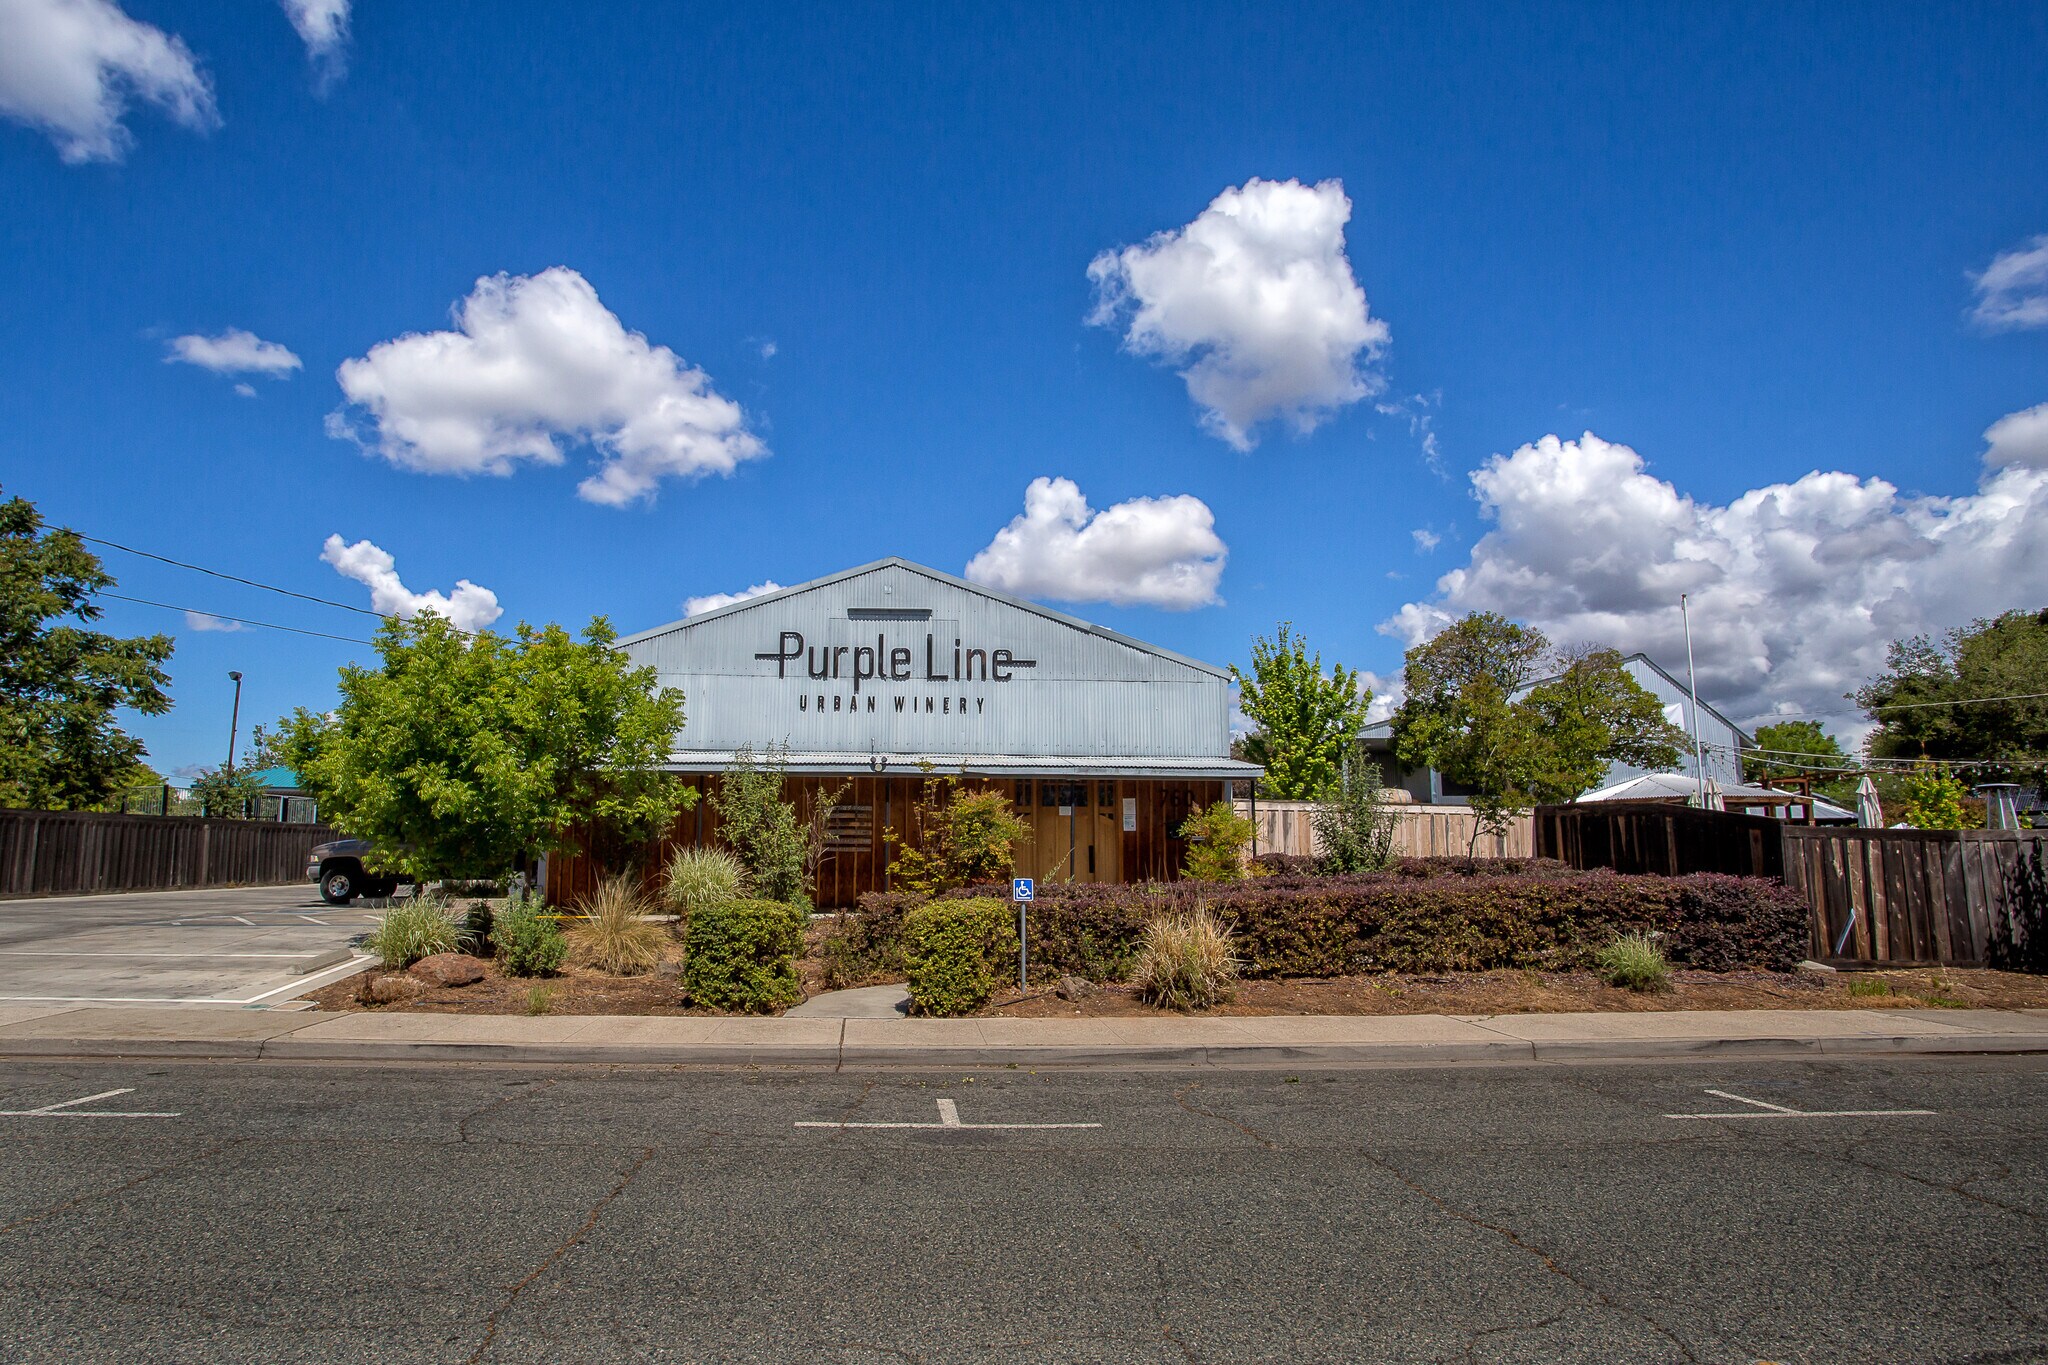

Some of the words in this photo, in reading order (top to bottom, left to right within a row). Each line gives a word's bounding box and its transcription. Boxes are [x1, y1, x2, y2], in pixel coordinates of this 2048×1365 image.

[755, 631, 912, 694] Purple
[926, 633, 1037, 683] Line
[799, 694, 876, 714] URBAN
[893, 696, 985, 715] WINERY
[1159, 789, 1195, 808] 760
